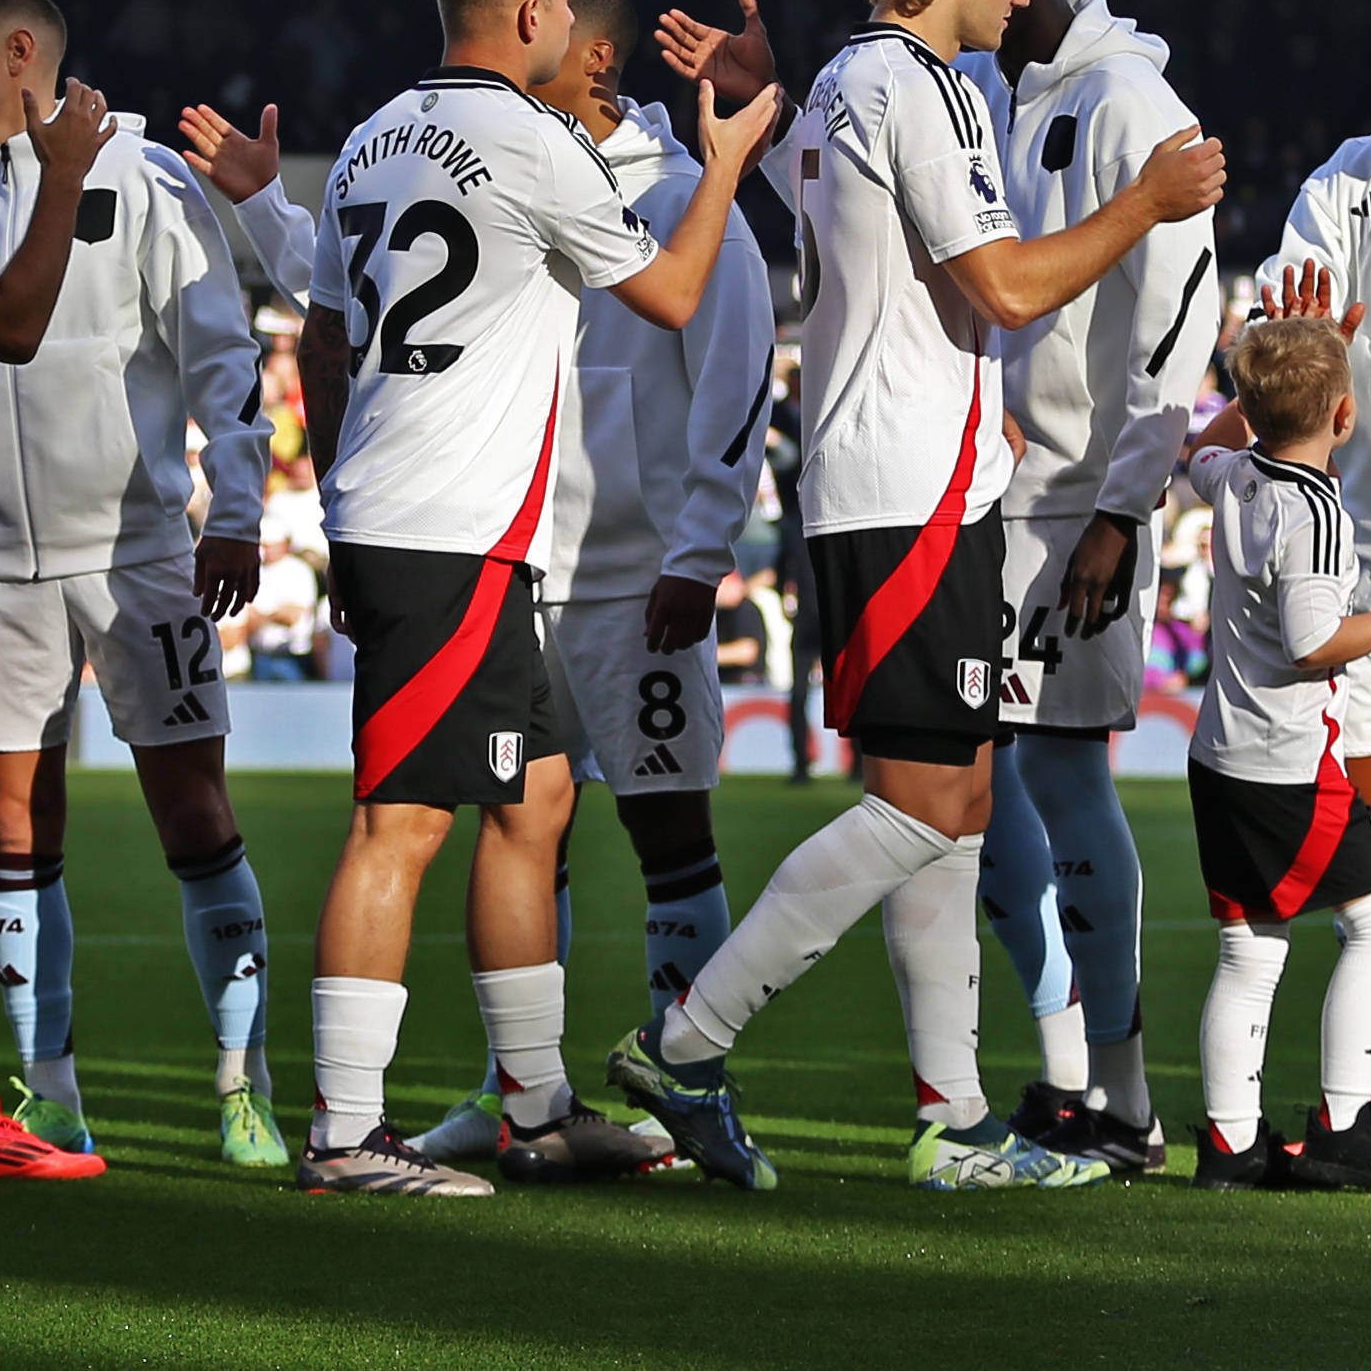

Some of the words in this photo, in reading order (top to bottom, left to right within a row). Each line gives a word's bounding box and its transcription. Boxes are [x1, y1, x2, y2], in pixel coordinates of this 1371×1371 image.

[335, 123, 415, 201] SMITH
[412, 123, 493, 197] ROWE
[336, 198, 480, 379] 32
[151, 615, 218, 690] 12
[637, 670, 687, 741] 8
